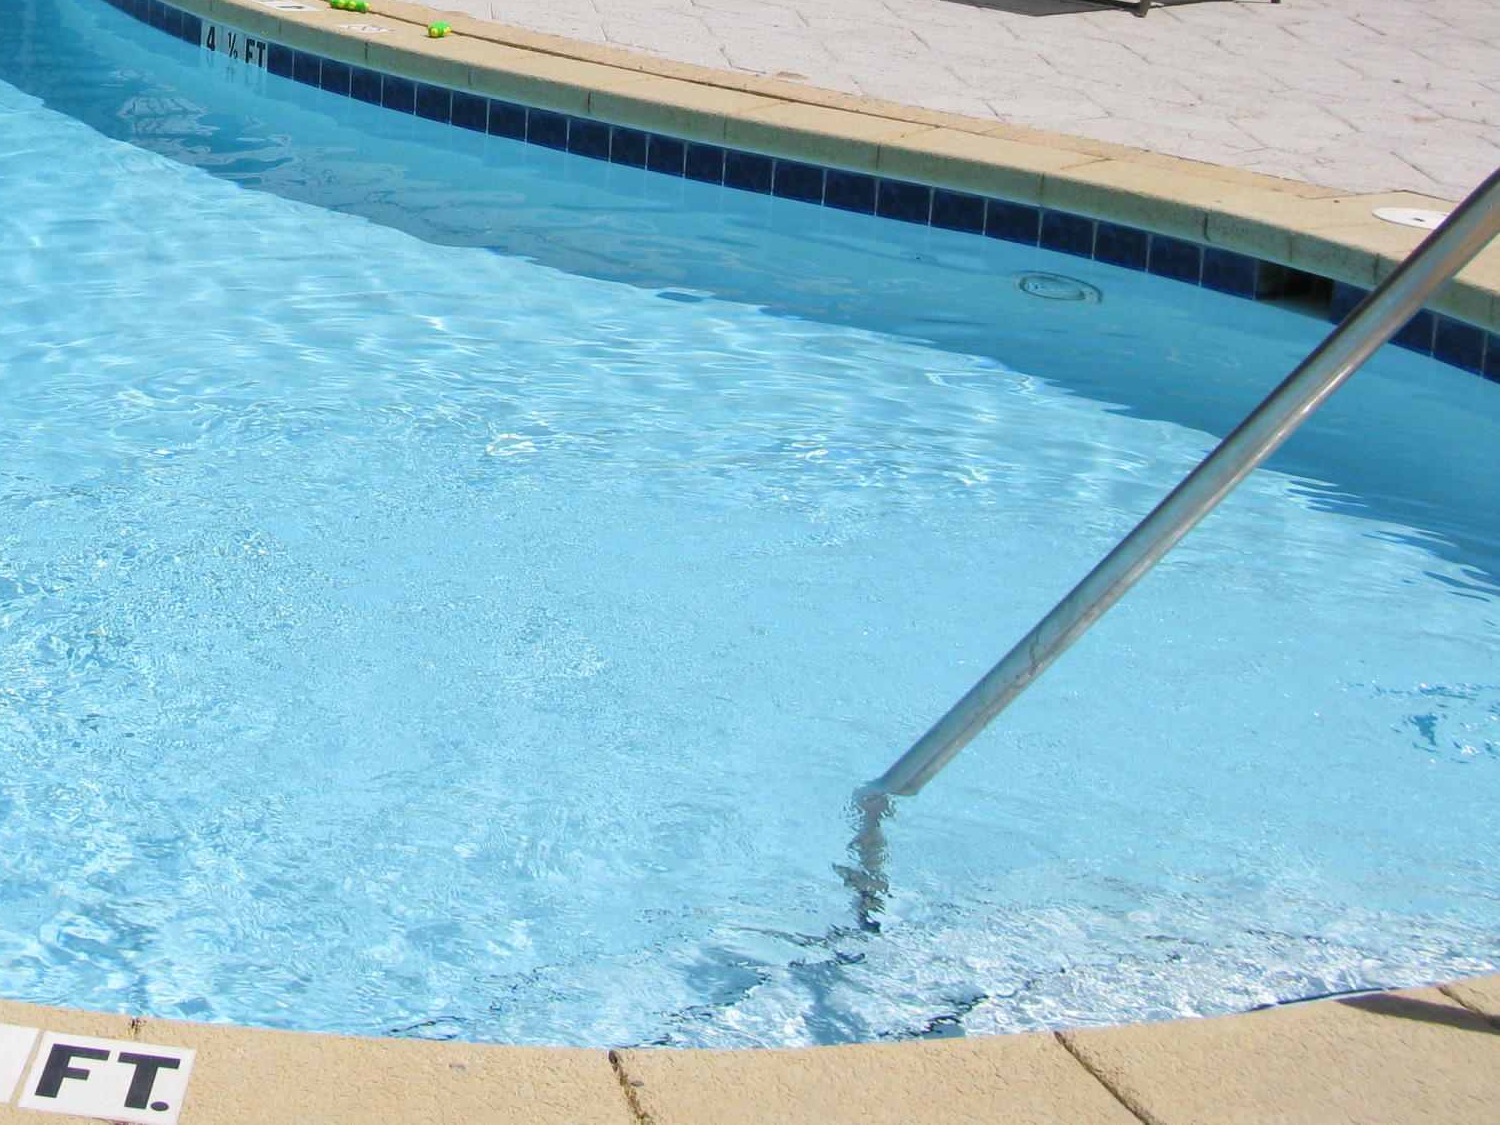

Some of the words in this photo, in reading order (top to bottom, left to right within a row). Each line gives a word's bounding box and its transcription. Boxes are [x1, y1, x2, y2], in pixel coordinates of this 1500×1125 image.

[206, 25, 216, 51] 4
[245, 37, 267, 68] FT
[34, 1043, 182, 1113] FT.
